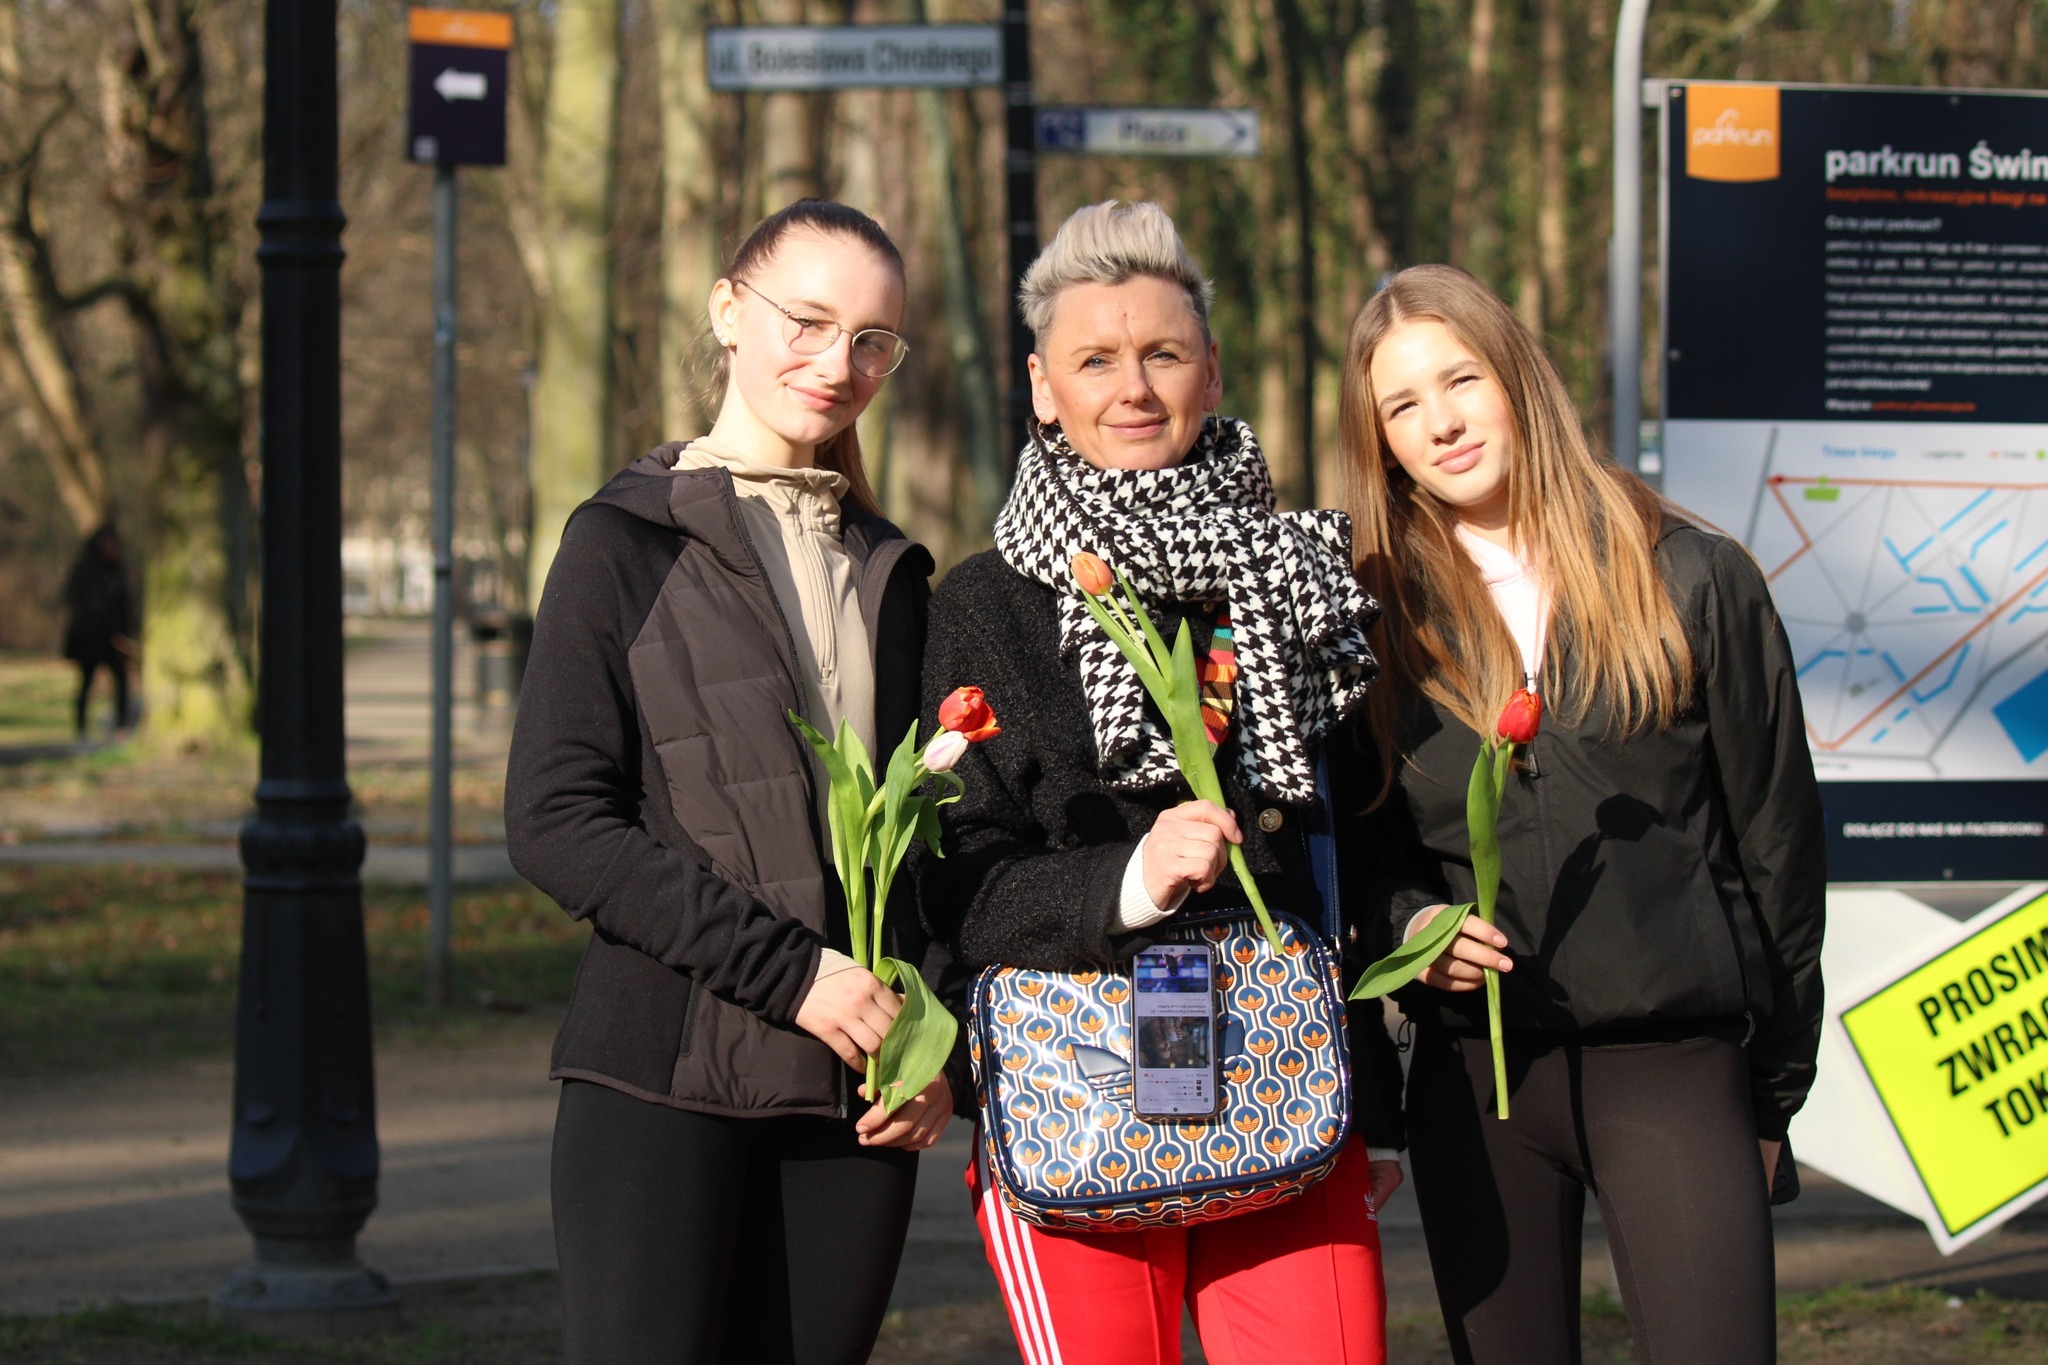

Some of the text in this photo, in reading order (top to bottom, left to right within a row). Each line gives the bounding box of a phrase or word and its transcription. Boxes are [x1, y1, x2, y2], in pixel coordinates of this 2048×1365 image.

[1692, 108, 1773, 147] parkrun
[1826, 145, 1960, 182] parkrun
[1897, 822, 1916, 837] DO
